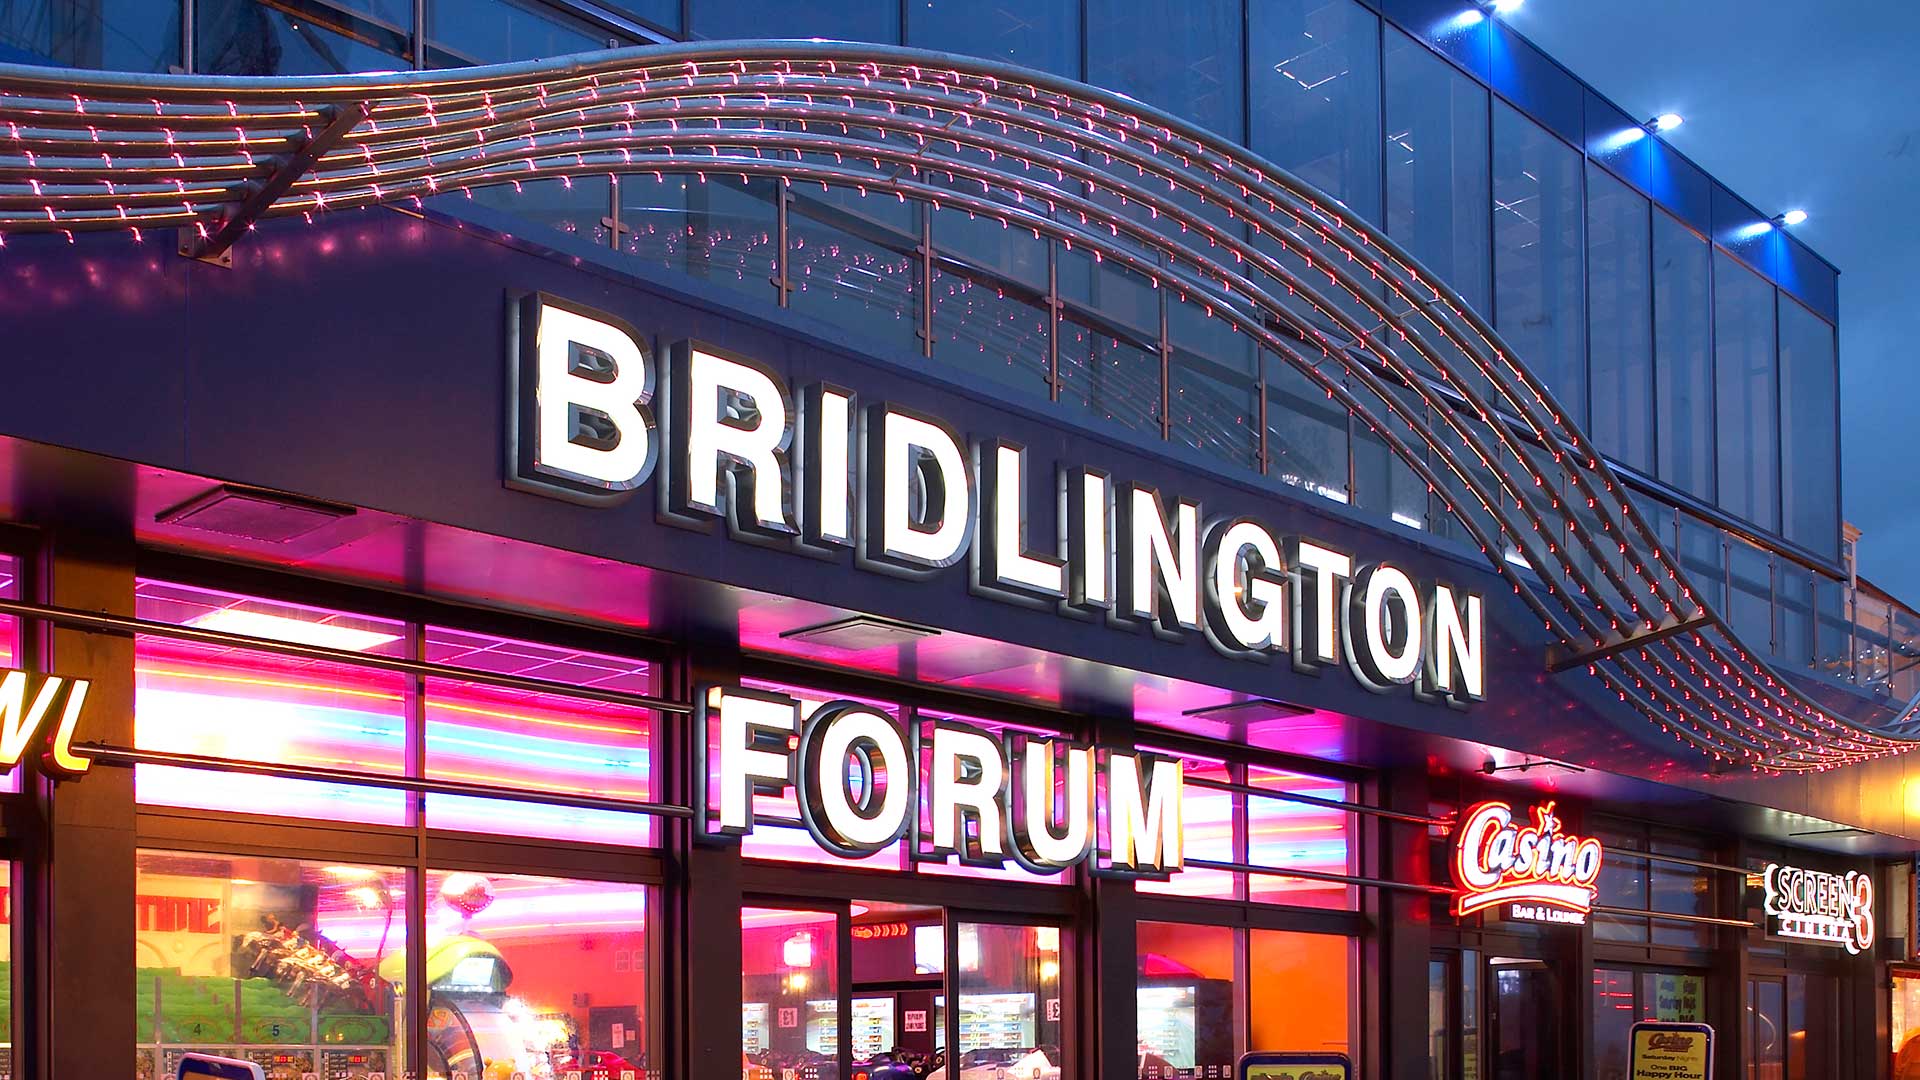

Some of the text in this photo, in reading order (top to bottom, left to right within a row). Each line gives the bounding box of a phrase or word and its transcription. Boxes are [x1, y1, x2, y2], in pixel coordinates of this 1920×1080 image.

[535, 296, 1487, 702] BRIDLINGTON
[718, 692, 1184, 872] FORUM
[1458, 802, 1602, 892] Casino
[1536, 905, 1546, 921] &
[1778, 866, 1873, 949] SCREEN 3
[1782, 919, 1851, 940] CINEMA
[193, 1023, 202, 1036] 4
[272, 1025, 280, 1037] 5
[1636, 1070, 1703, 1080] Happy Hour
